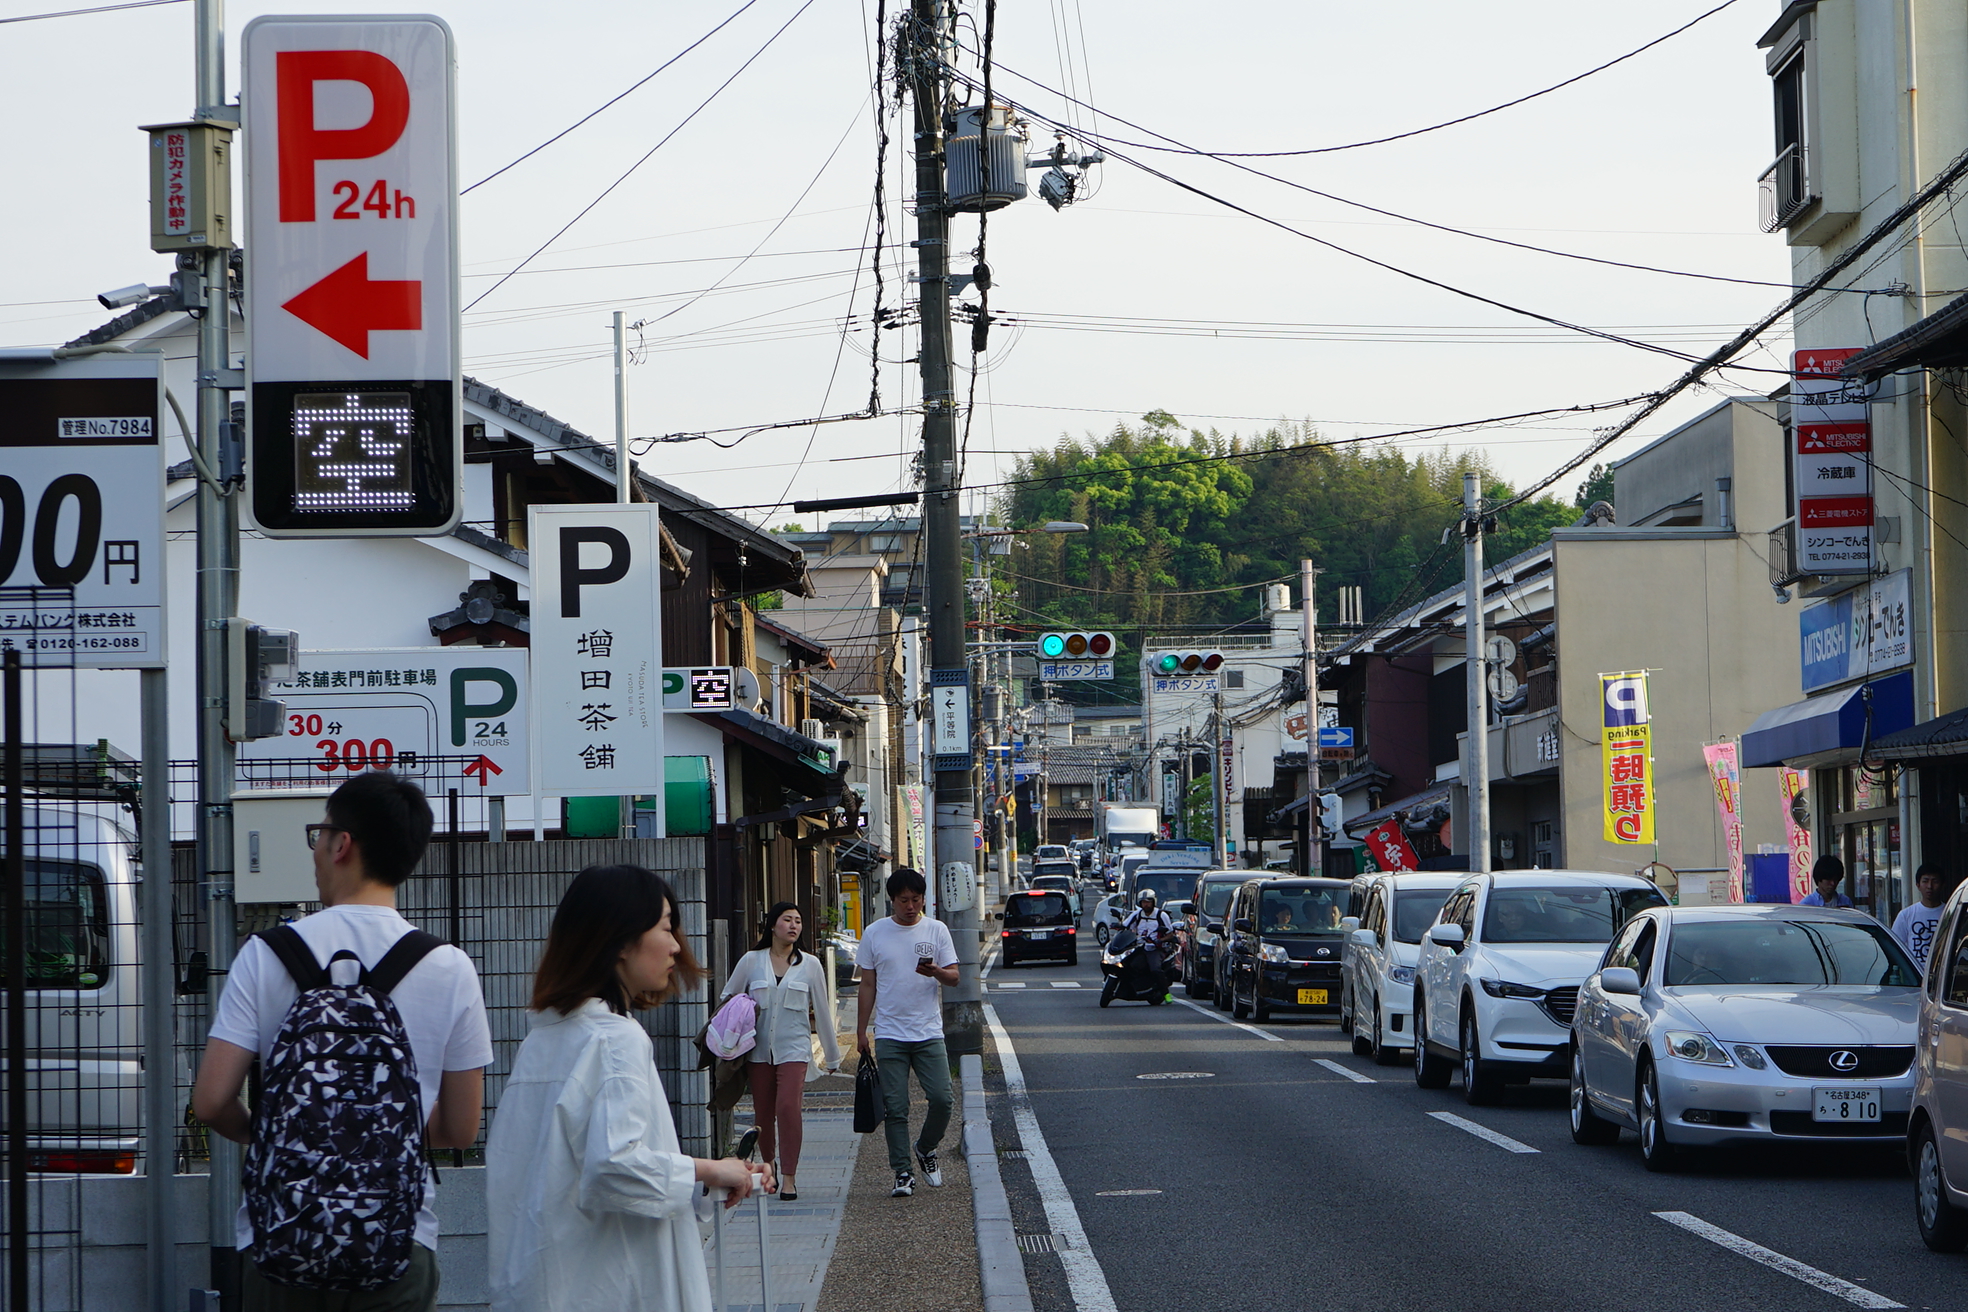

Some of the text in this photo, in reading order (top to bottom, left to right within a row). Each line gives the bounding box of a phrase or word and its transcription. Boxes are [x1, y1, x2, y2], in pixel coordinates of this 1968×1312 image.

[276, 50, 410, 222] P
[167, 134, 186, 230] 防犯カメラ作動中
[332, 180, 416, 219] 24h
[1826, 433, 1867, 441] MITSUBISHI
[294, 394, 413, 505] 空
[1817, 466, 1856, 479] 冷蔵庫
[1808, 536, 1870, 548] シンコーでんき
[1808, 553, 1821, 561] TEL
[560, 526, 631, 618] P
[0, 612, 136, 628] テムバンク株式会社
[41, 637, 139, 649] 0120-162-088
[1804, 622, 1847, 666] MITSUBISHI
[1044, 664, 1110, 678] 押ボタン式
[692, 670, 730, 707] 空
[1156, 677, 1217, 692] 押ボタン式
[450, 667, 518, 747] P
[474, 721, 508, 738] 24
[473, 738, 510, 747] HOURS
[916, 944, 933, 954] DEUS
